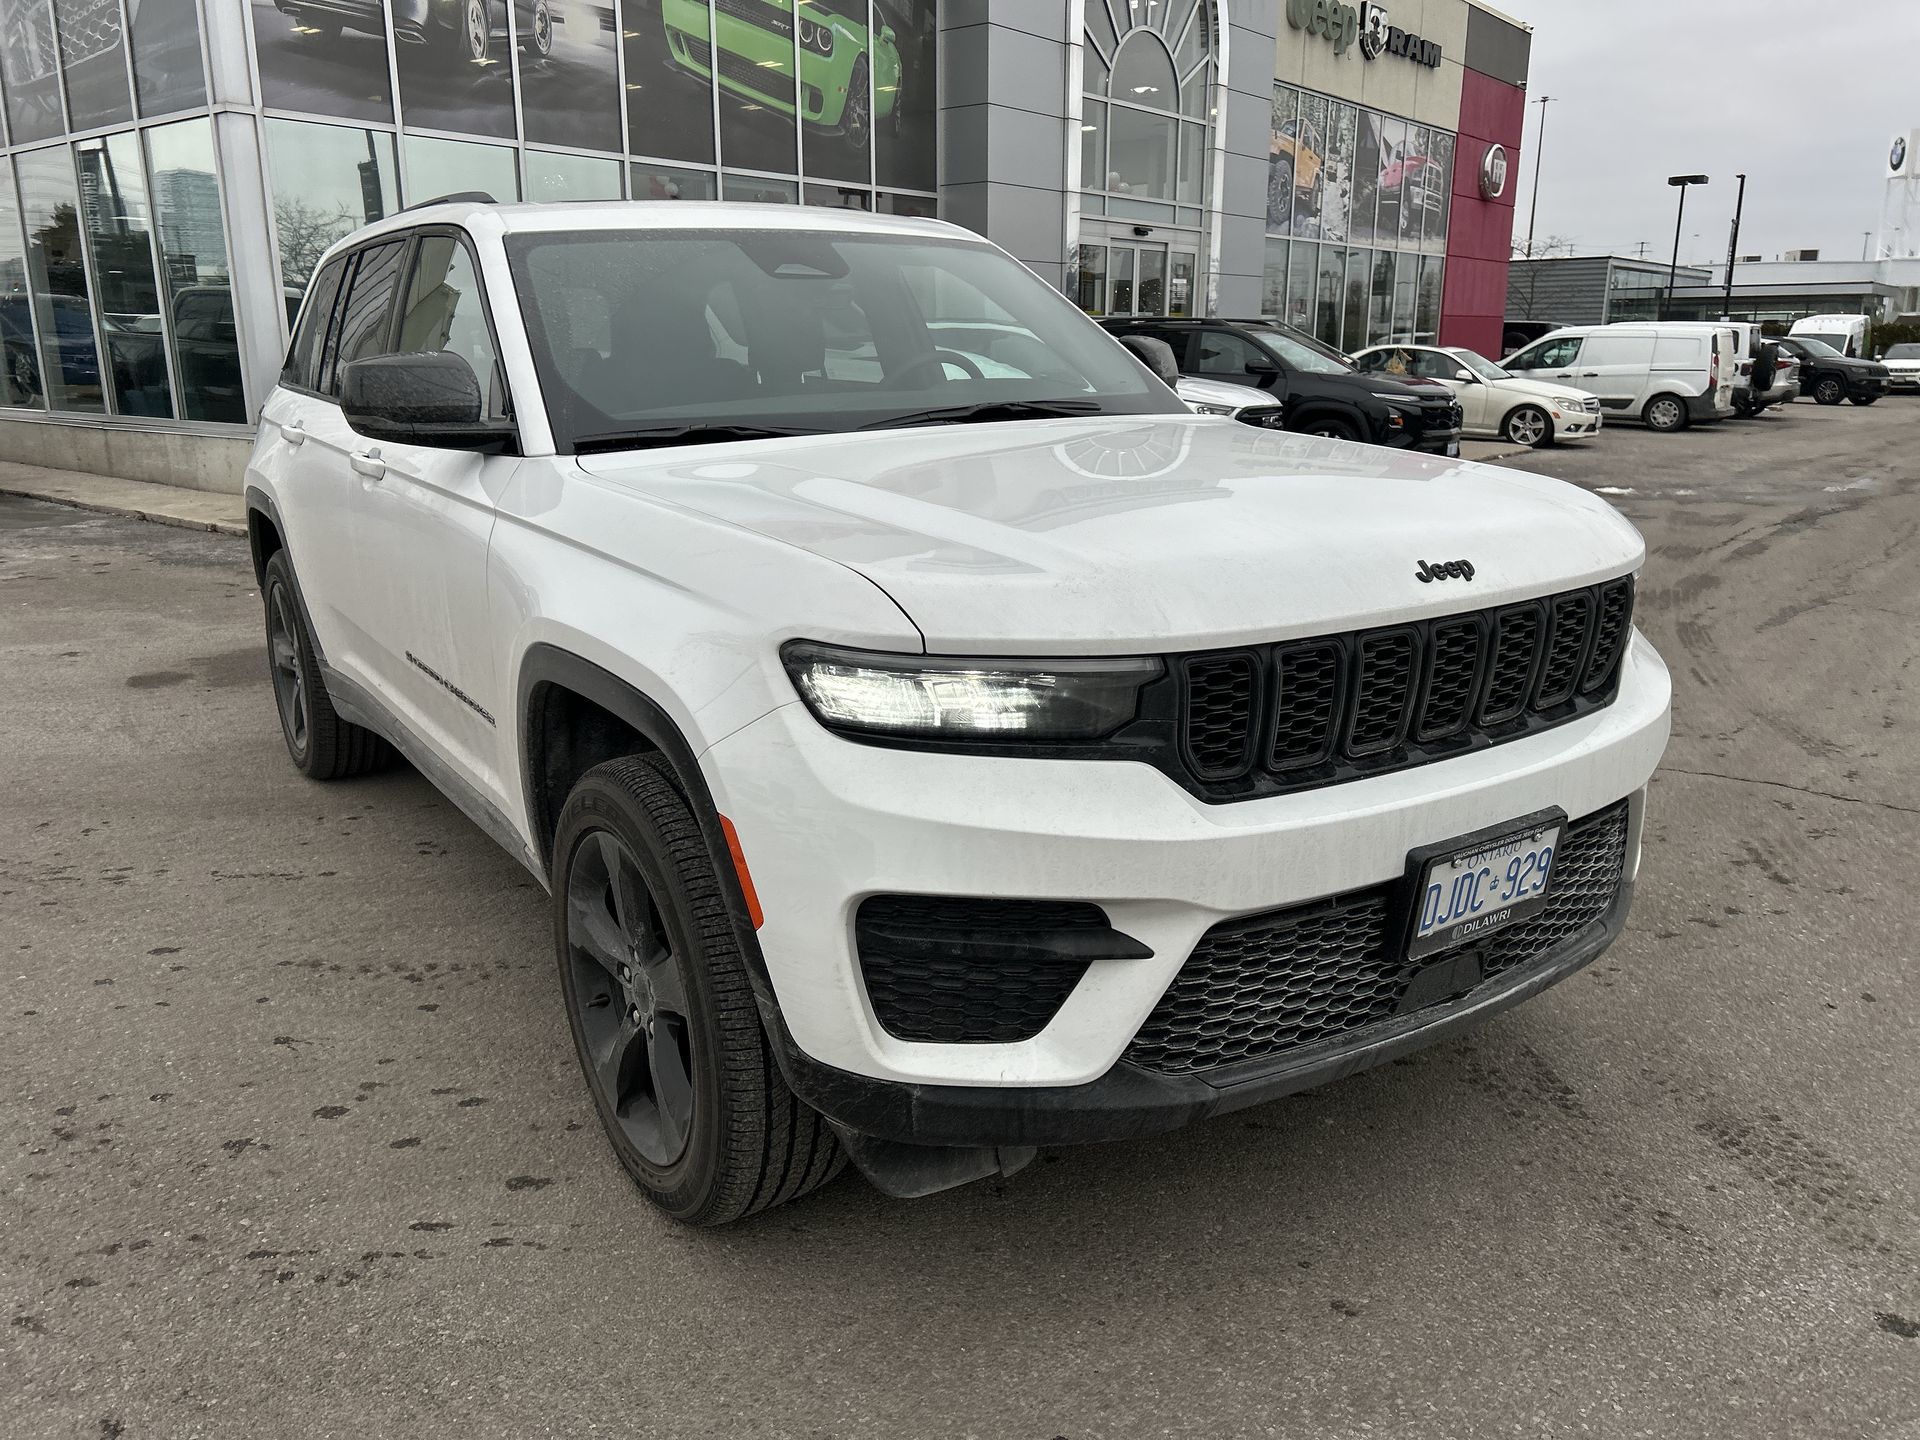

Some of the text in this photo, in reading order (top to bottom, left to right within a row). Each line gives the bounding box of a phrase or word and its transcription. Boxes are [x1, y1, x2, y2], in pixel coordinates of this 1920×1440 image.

[1388, 25, 1442, 68] RAM
[1415, 559, 1475, 583] Jeep
[1468, 842, 1522, 869] ONTARIO
[1421, 867, 1490, 931] DJDC
[1502, 846, 1552, 900] 929
[1463, 908, 1511, 934] DILAWRI
